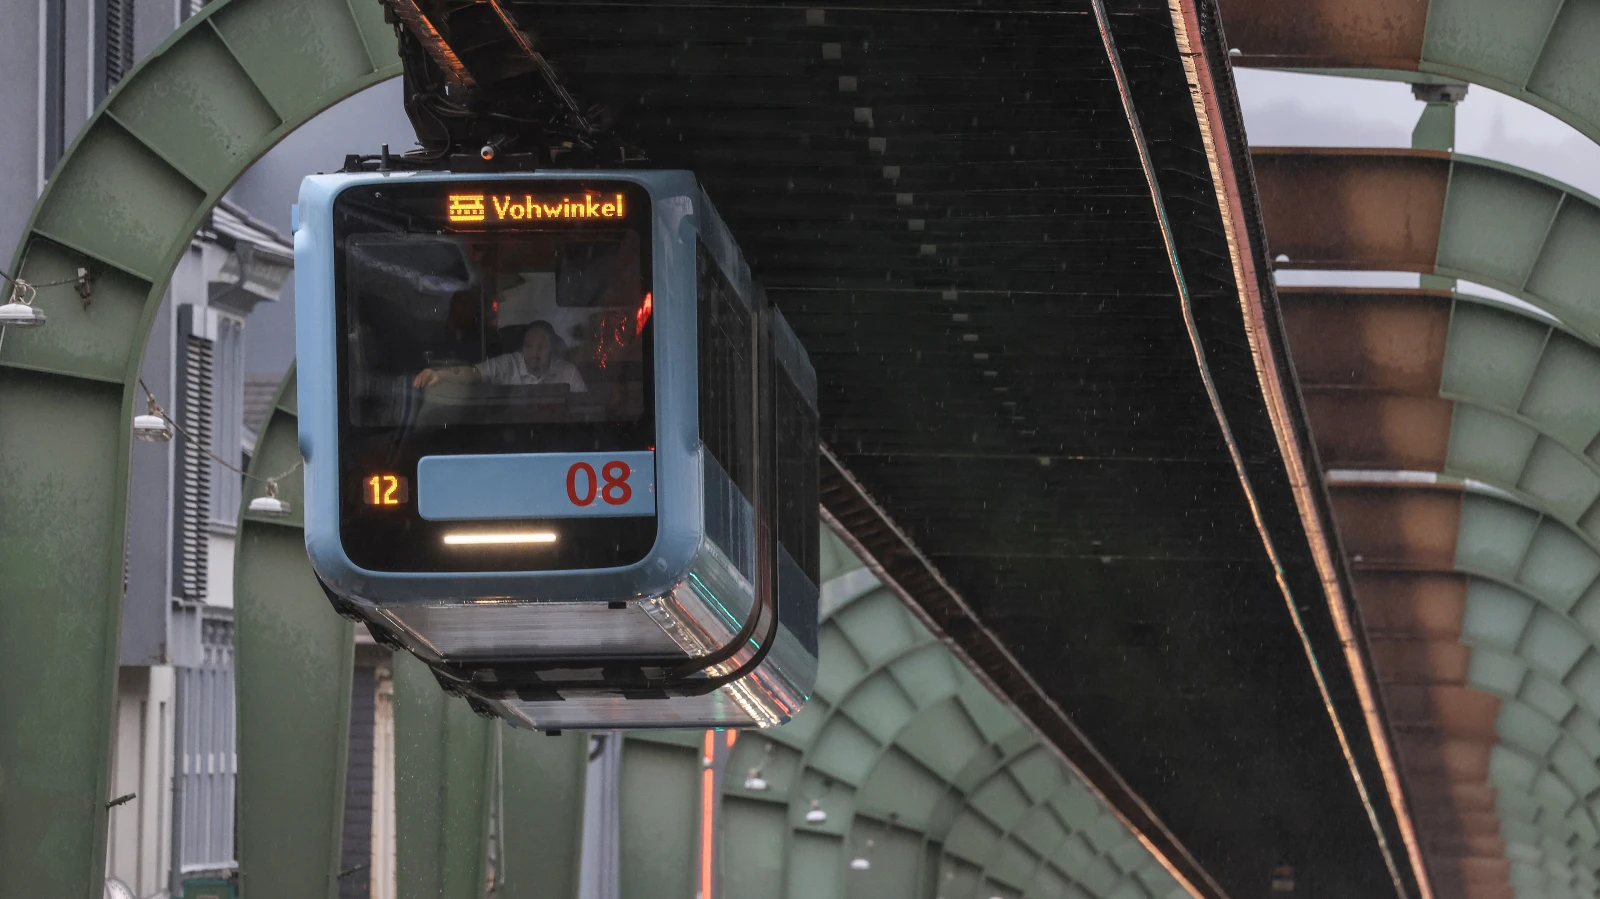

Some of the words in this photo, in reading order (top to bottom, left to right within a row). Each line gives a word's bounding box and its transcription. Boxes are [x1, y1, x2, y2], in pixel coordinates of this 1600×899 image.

[493, 194, 623, 220] Vohwinkel
[369, 475, 398, 505] 12
[566, 460, 632, 507] 08
